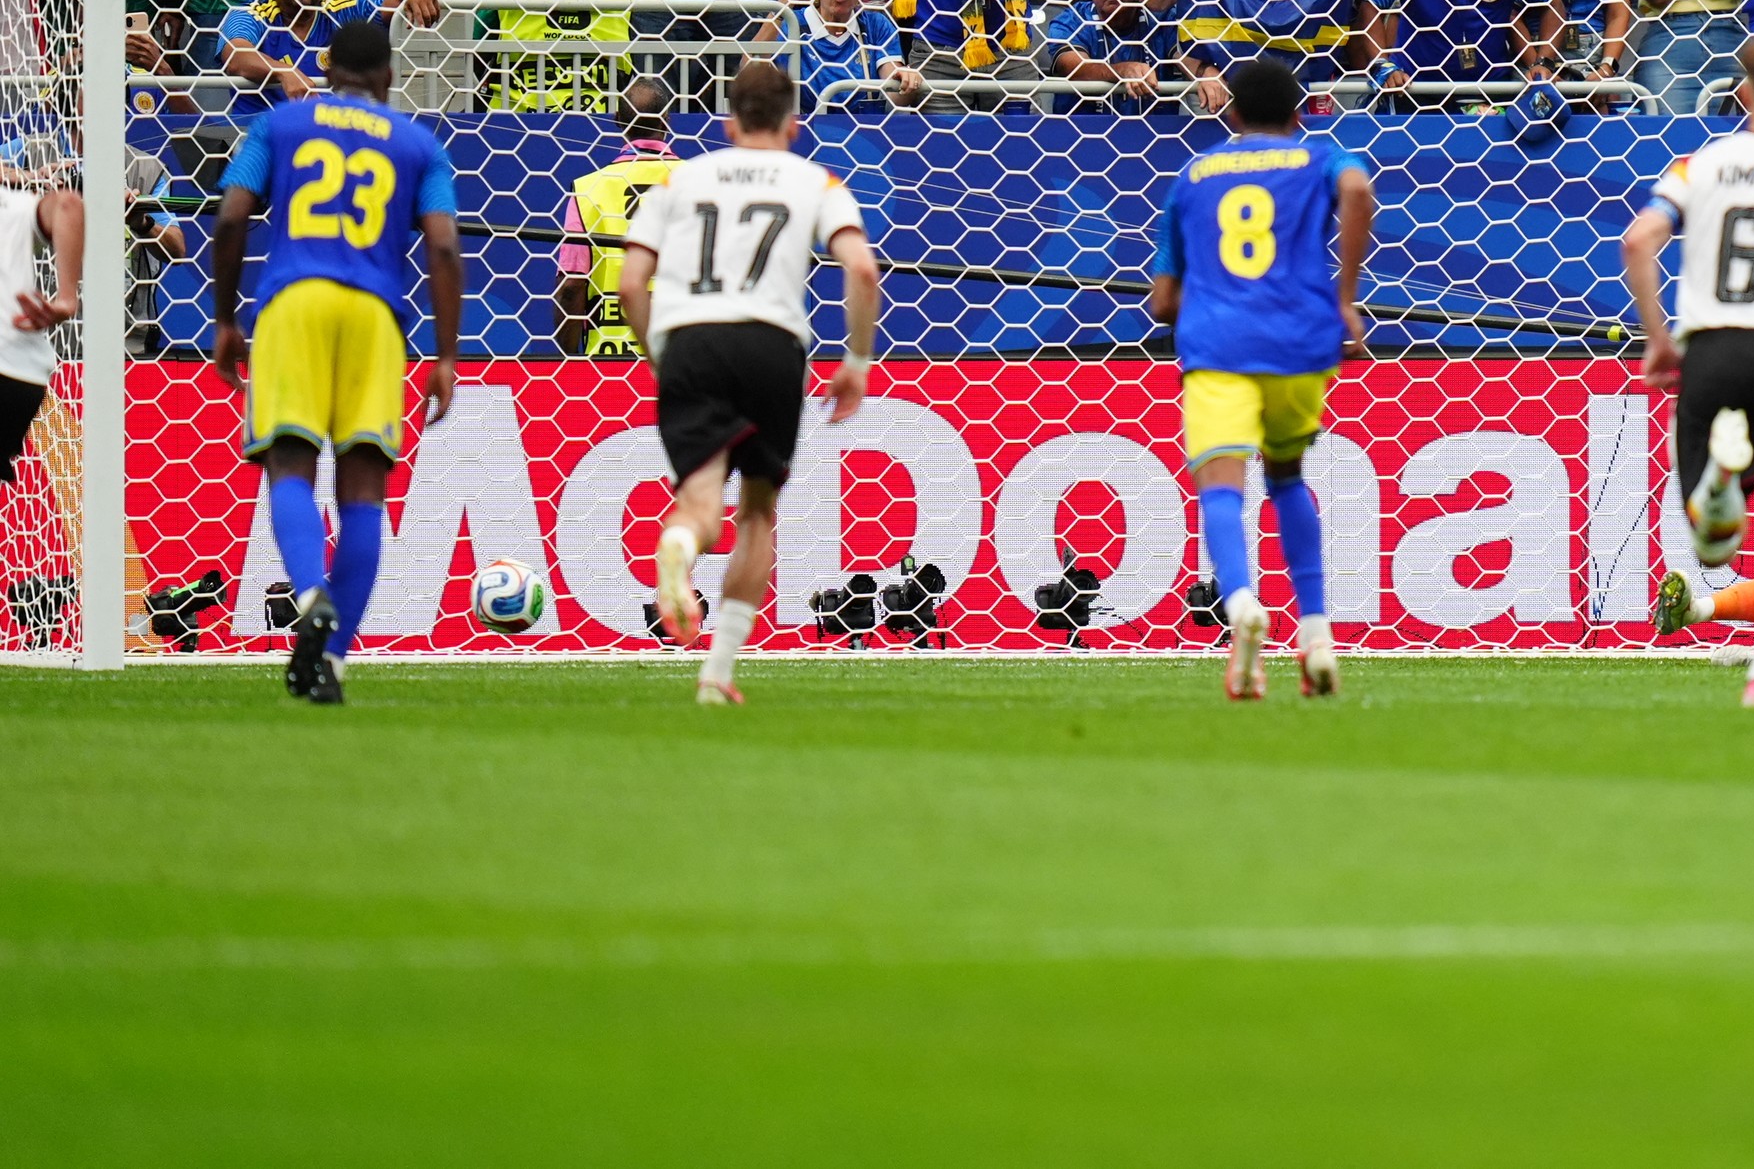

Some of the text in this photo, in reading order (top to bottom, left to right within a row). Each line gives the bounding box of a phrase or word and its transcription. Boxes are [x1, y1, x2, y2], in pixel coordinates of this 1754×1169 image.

[558, 15, 580, 25] FIFA
[288, 137, 397, 250] 23
[716, 165, 782, 185] WIRTZ
[688, 201, 790, 295] 17
[1217, 183, 1277, 280] 8
